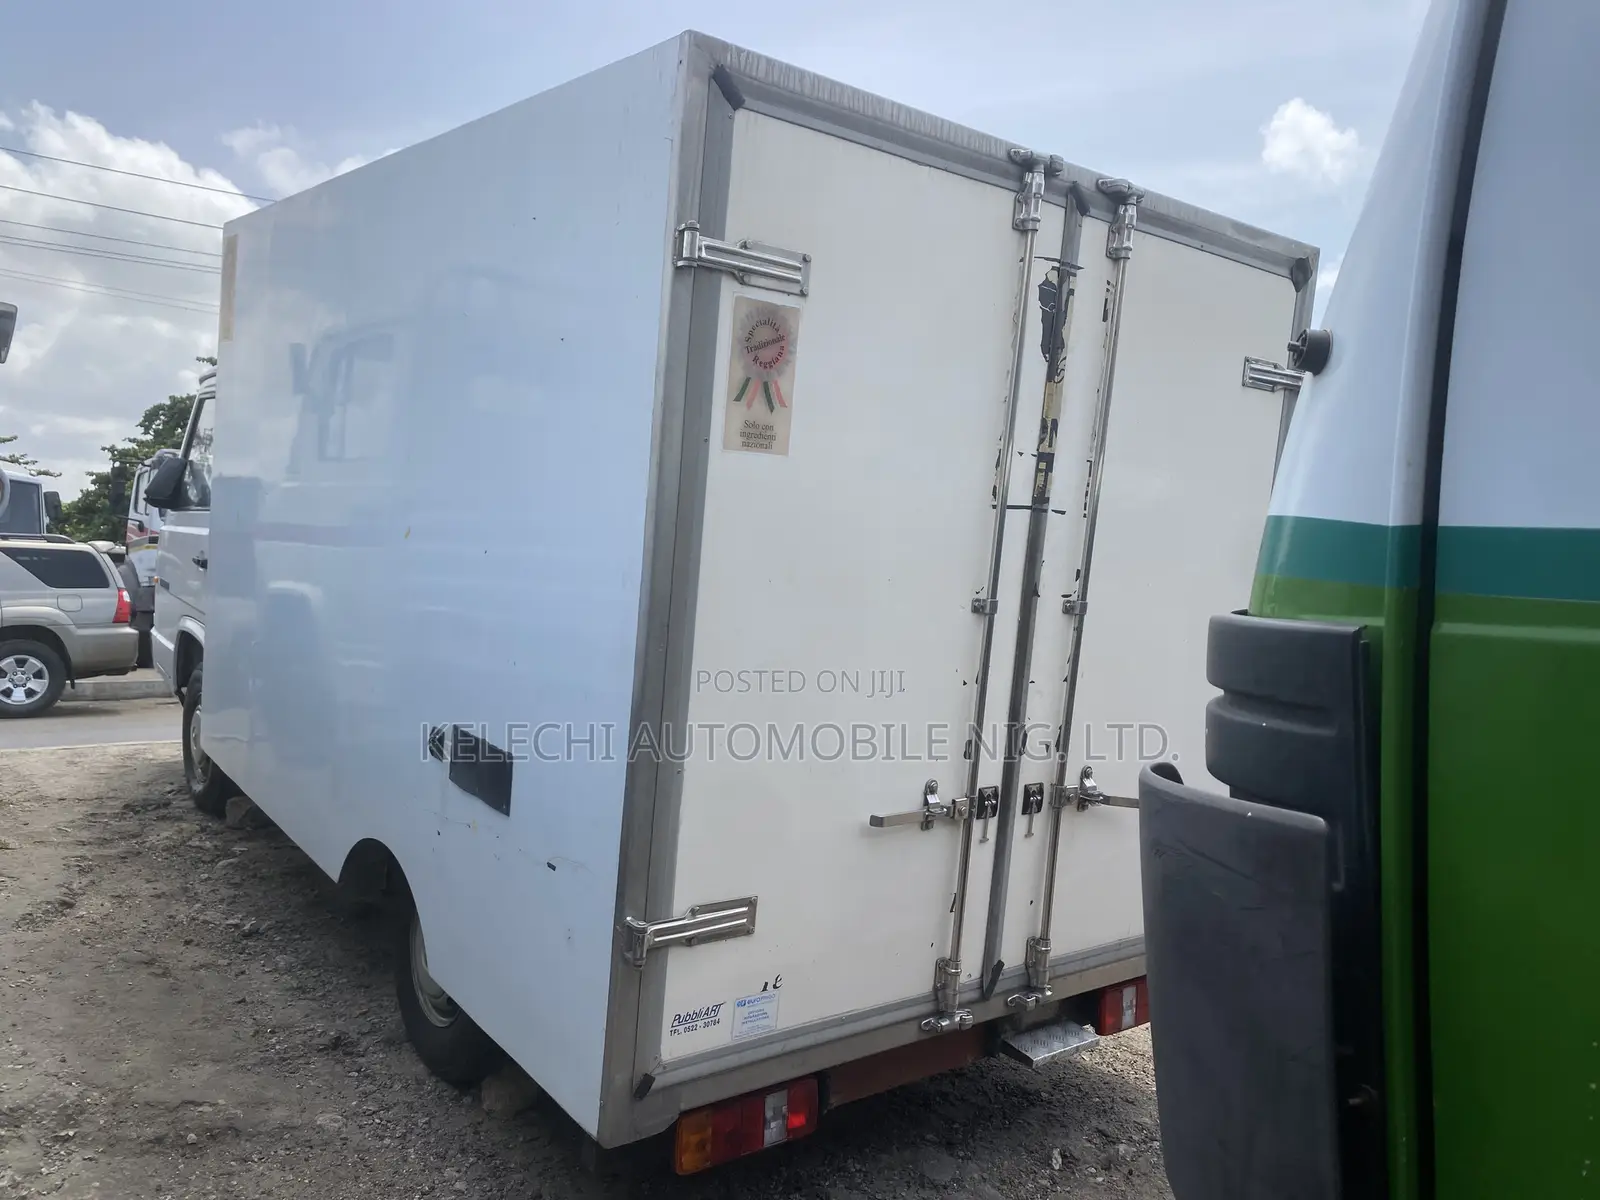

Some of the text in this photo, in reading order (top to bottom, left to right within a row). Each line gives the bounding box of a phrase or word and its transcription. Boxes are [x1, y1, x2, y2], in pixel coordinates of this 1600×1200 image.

[744, 420, 760, 430] Solo
[740, 429, 777, 442] ingredienti
[741, 440, 773, 450] nazionali
[683, 1023, 698, 1034] 0522
